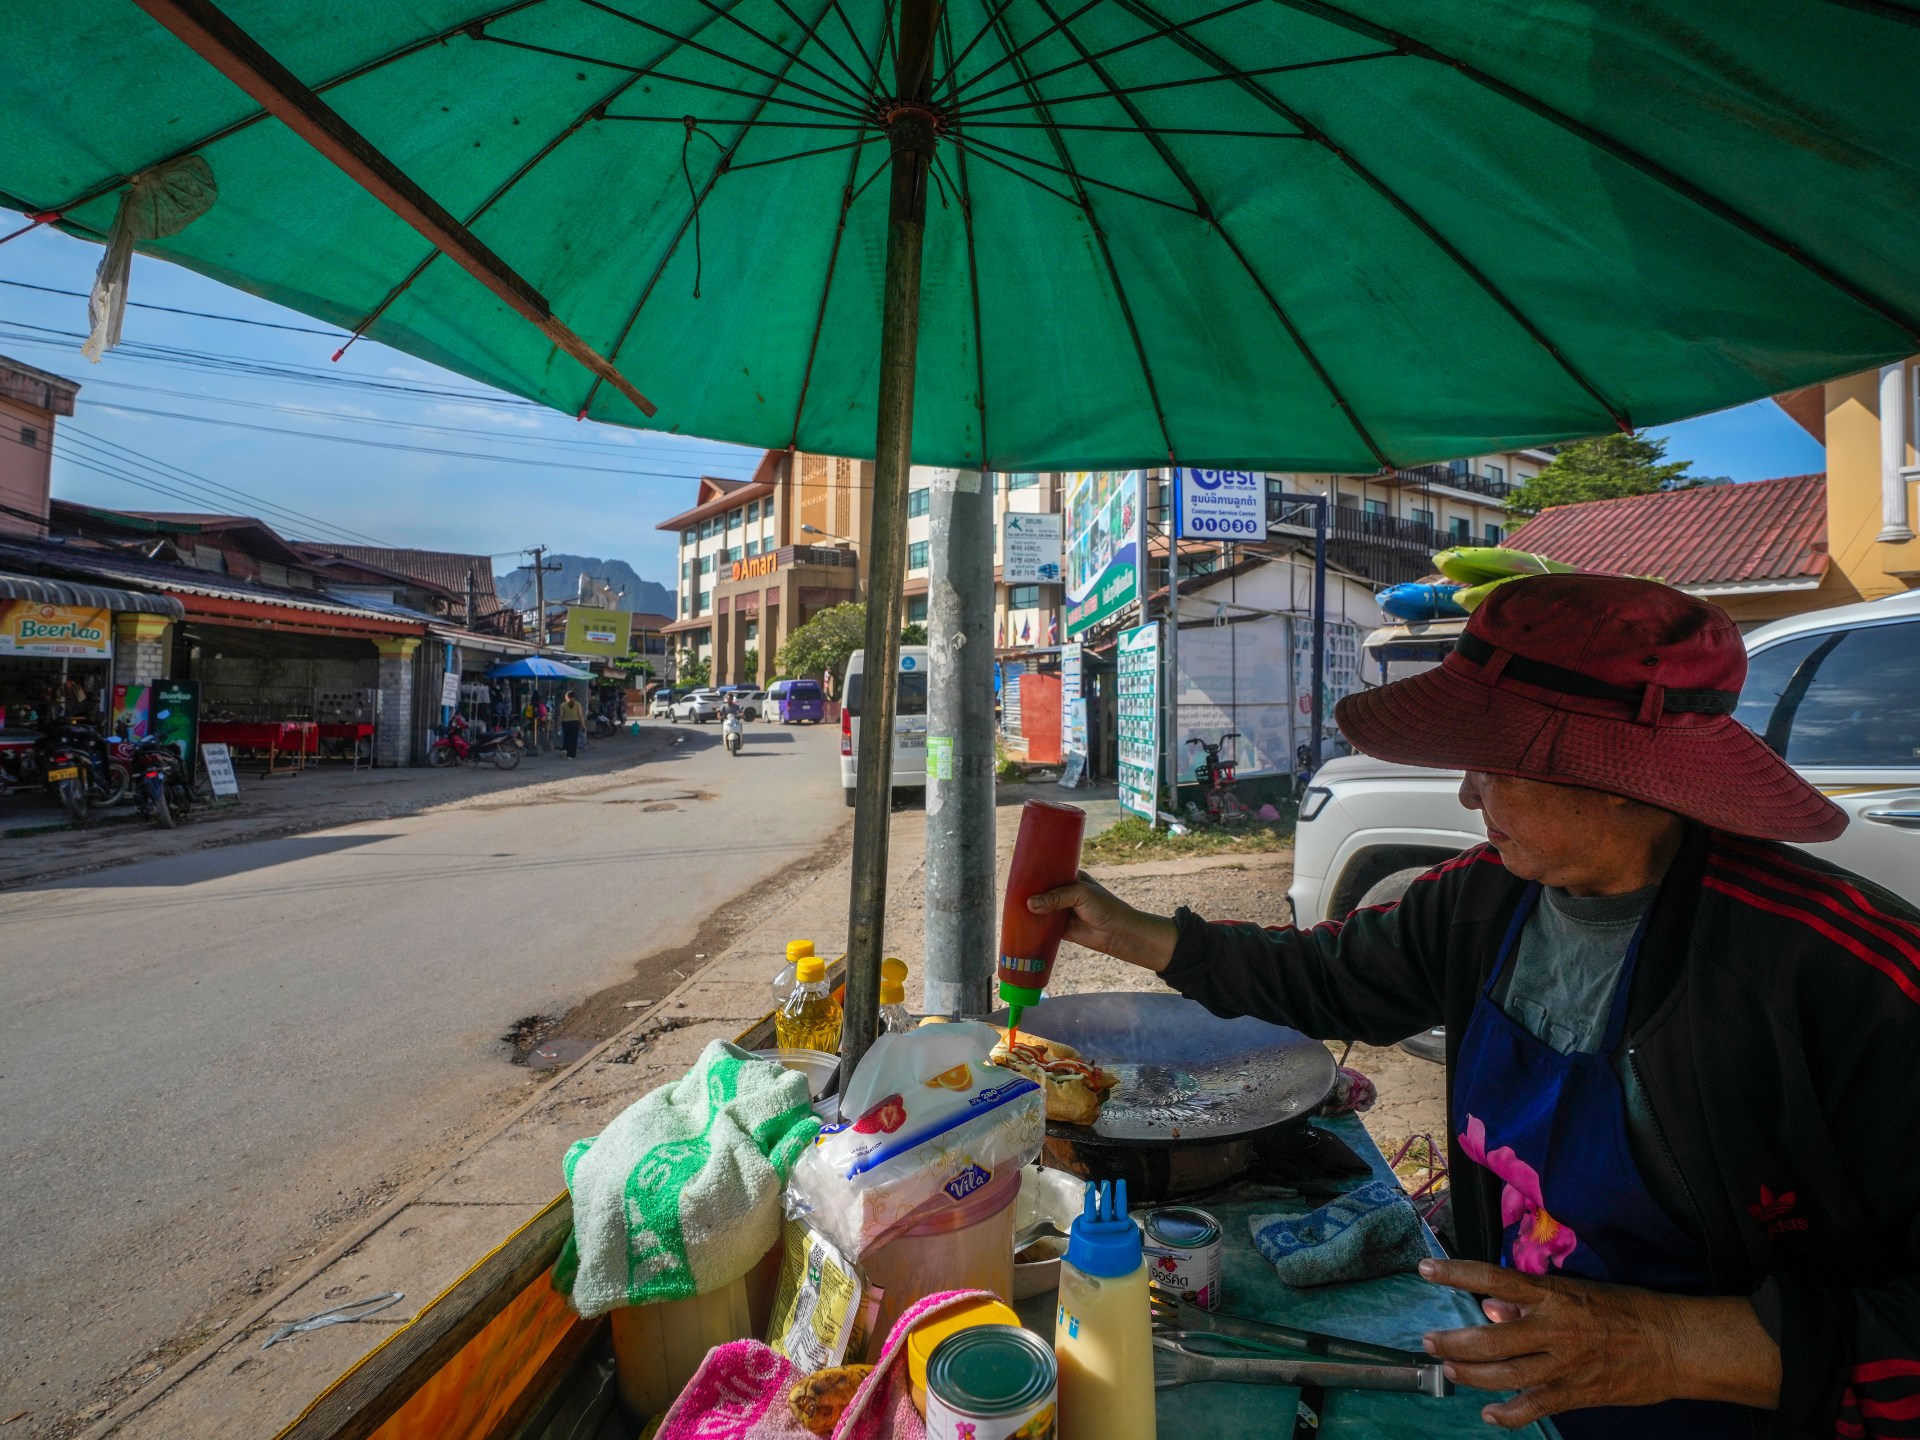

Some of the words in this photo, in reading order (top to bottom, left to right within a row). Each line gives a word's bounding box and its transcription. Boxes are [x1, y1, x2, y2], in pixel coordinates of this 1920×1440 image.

[741, 552, 777, 580] Amari
[21, 620, 101, 641] Beerlao
[981, 1088, 998, 1101] 280
[950, 1171, 983, 1197] Vila
